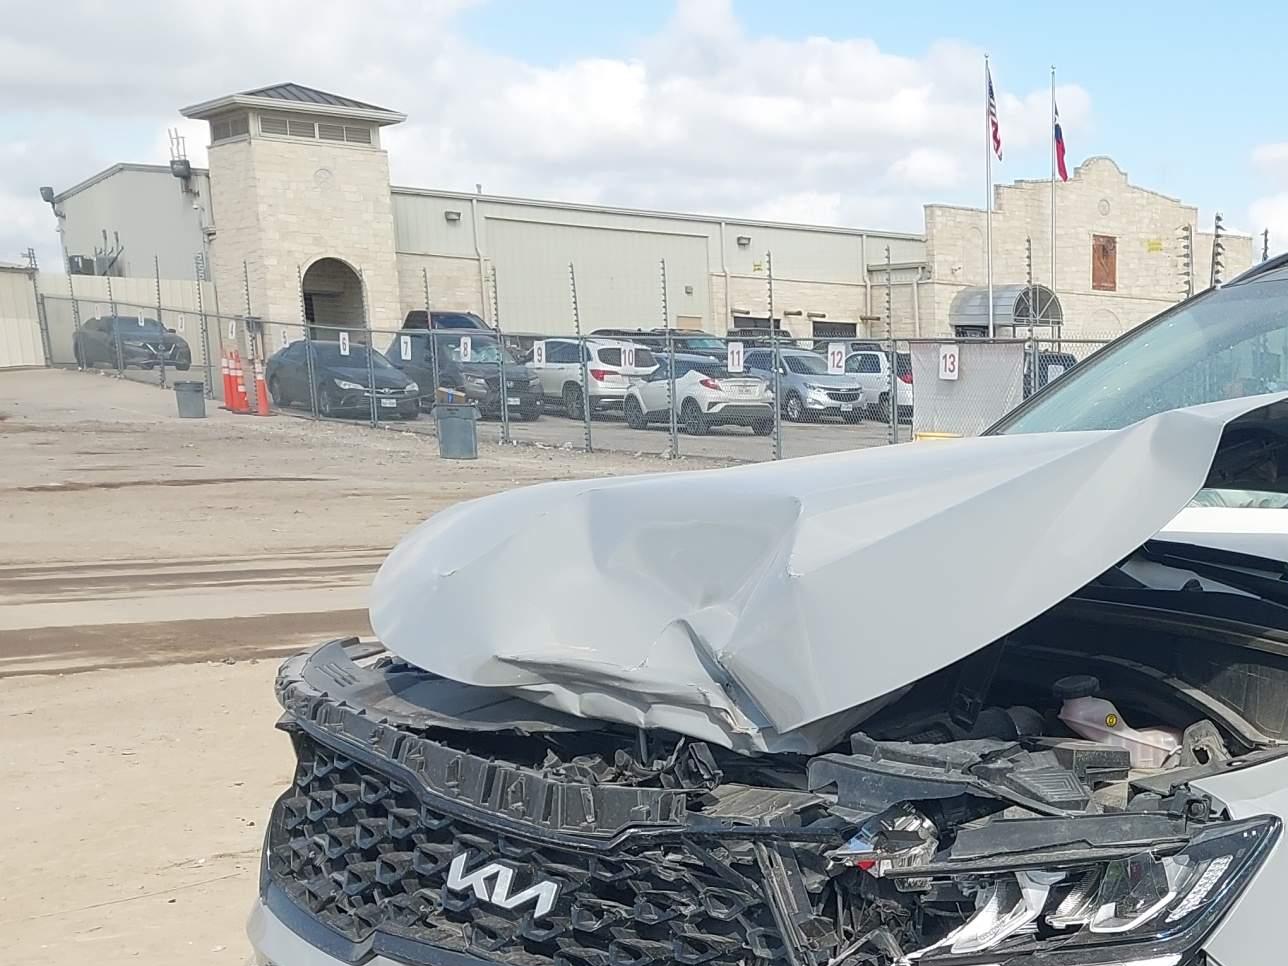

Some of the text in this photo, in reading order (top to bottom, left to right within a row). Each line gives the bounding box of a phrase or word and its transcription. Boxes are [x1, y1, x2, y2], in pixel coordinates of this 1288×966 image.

[536, 346, 543, 363] 9
[623, 349, 634, 366] 10
[730, 350, 740, 367] 11
[830, 350, 843, 369] 12
[942, 353, 956, 373] 13
